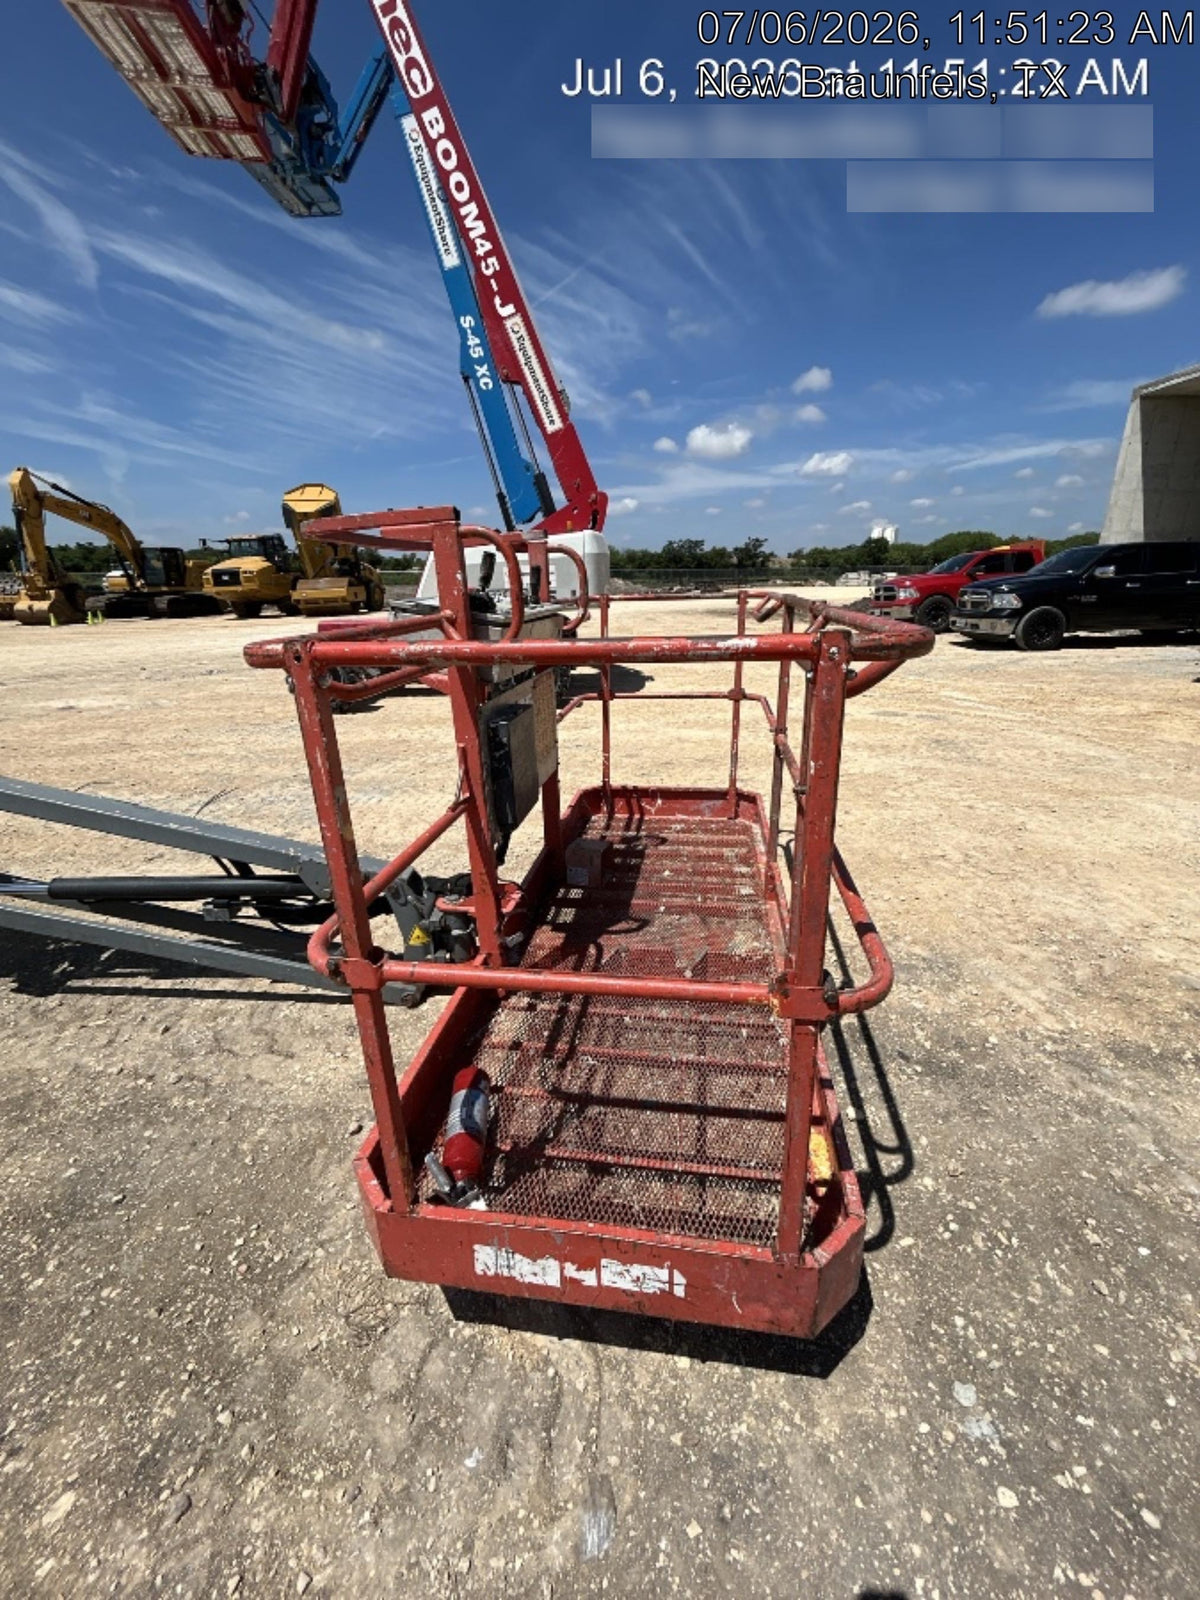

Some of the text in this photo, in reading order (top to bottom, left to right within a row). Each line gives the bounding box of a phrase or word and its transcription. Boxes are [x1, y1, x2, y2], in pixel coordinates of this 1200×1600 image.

[413, 143, 451, 256] EquipmentShare
[460, 315, 493, 390] S-45 XC
[516, 334, 555, 426] EquipmentShare
